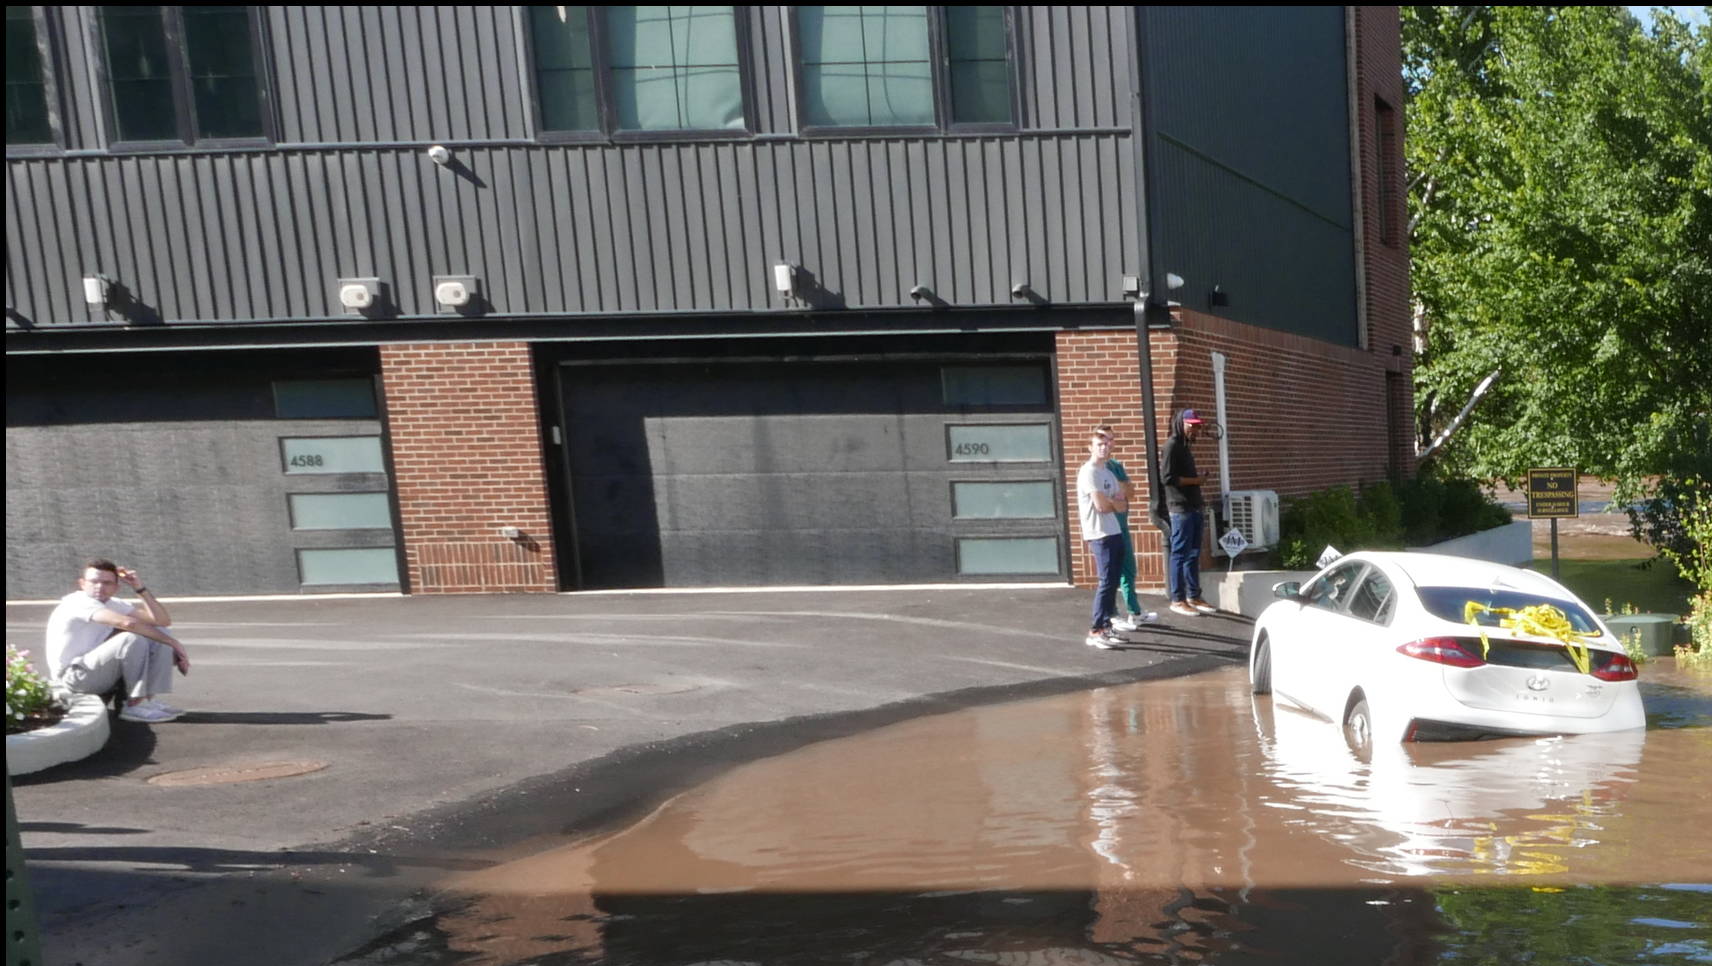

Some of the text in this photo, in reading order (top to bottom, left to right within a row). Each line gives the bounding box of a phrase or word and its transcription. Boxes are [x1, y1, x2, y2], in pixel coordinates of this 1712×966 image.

[955, 443, 989, 455] 4590
[290, 454, 324, 467] 4588
[1546, 481, 1558, 489] NO
